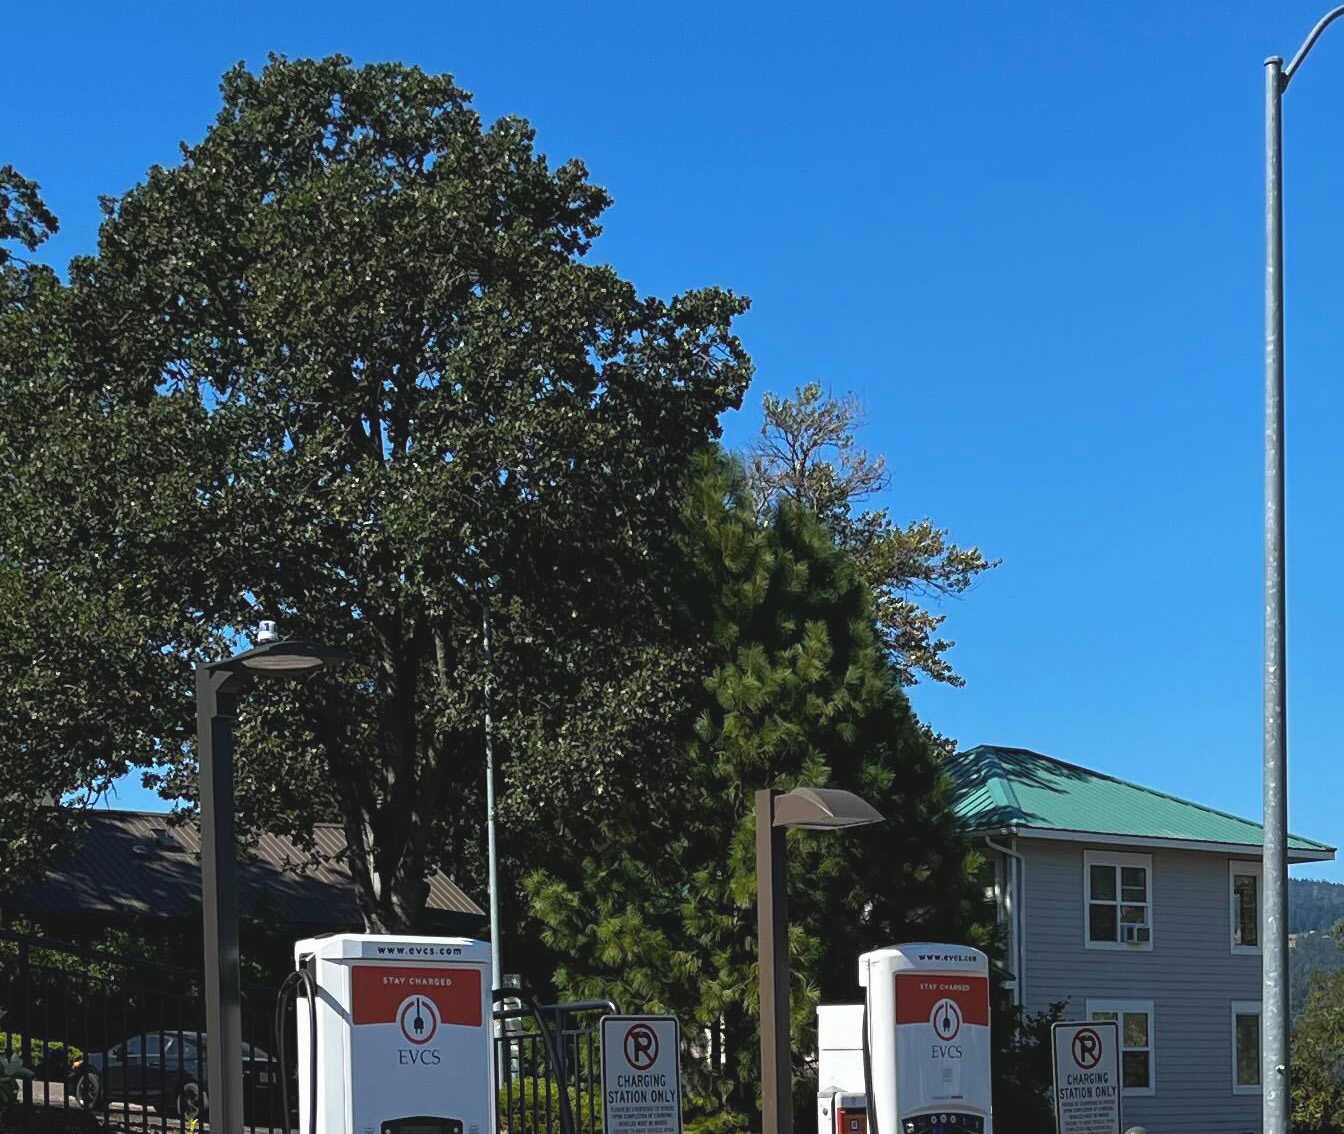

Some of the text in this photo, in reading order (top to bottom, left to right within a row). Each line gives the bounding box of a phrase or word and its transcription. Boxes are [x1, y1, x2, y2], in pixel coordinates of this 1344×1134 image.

[377, 946, 462, 956] www.evcs.com
[383, 976, 452, 986] STAY CHARGED
[919, 982, 937, 990] STAY
[398, 1049, 441, 1065] EVCS
[931, 1045, 963, 1059] EVCS
[617, 1074, 666, 1088] CHARGING
[1067, 1072, 1109, 1086] CHARGING
[608, 1089, 676, 1104] STATION ONLY
[1059, 1085, 1117, 1100] STATION ONLY
